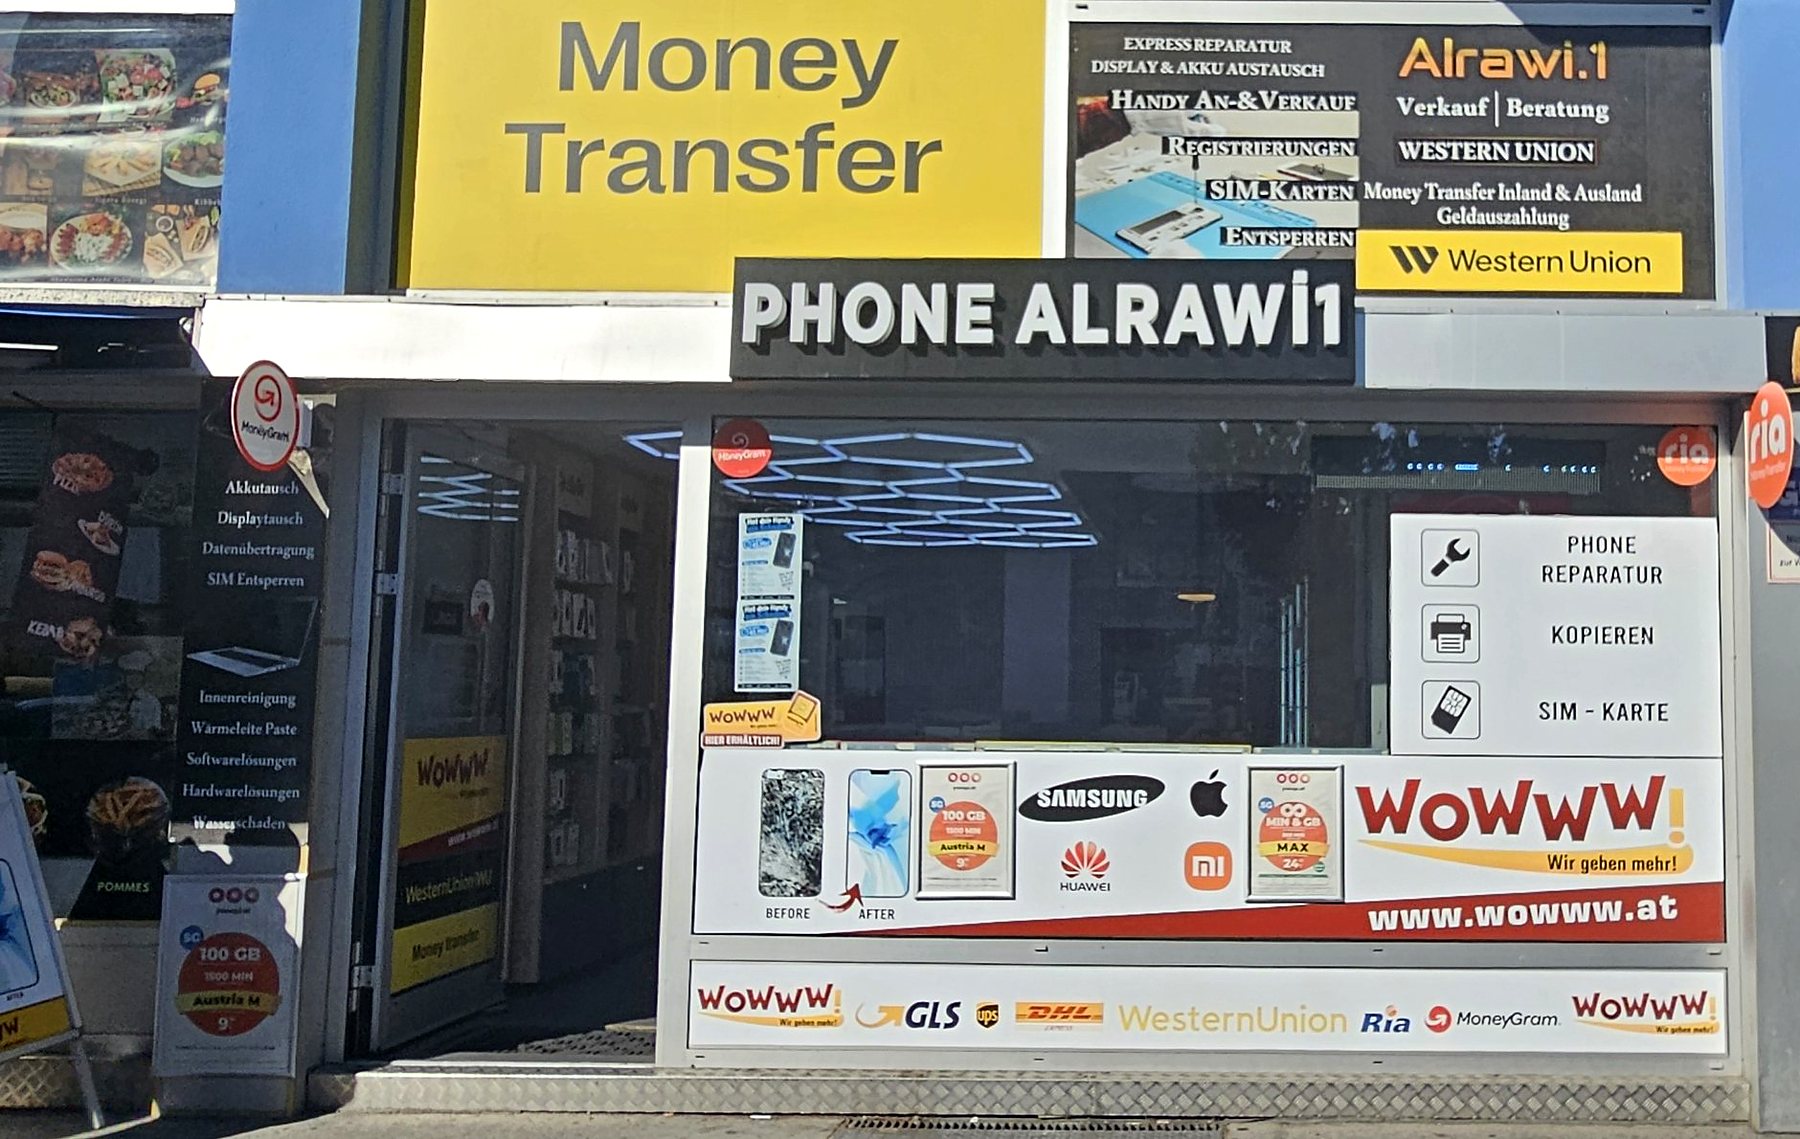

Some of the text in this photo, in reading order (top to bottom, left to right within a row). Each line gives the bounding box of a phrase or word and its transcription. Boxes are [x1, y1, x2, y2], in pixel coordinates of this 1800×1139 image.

[1124, 37, 1292, 53] EXPRESS REPARATUR
[559, 21, 900, 109] Money
[1091, 60, 1325, 78] DISPLAY & AKKU AUSTAUSCH
[1396, 96, 1610, 124] Verkauf Beratung
[505, 122, 942, 194] Transfer
[1399, 141, 1595, 162] WESTERN UNION
[1363, 182, 1642, 205] Money Transfer Inland & Ausland
[1437, 206, 1570, 231] Geldauszahlung
[1448, 248, 1651, 274] Western Union
[741, 282, 998, 347] PHONE
[241, 420, 290, 442] MoneyGram
[1750, 399, 1786, 465] ria
[1664, 433, 1709, 465] ria
[225, 480, 299, 496] Akkutausch
[217, 510, 303, 529] Displaytausch
[202, 541, 315, 560] Datenübertragung
[1568, 535, 1636, 555] PHONE
[207, 573, 305, 590] SIM Entsperren
[1541, 565, 1663, 585] REPARATUR
[1551, 626, 1654, 645] KOPIEREN
[199, 690, 296, 709] Innenreinigung
[1539, 702, 1577, 721] SIM
[1602, 702, 1669, 722] KARTE
[265, 721, 298, 735] Paste
[186, 752, 297, 771] Softwarelösungen
[1037, 789, 1148, 809] SAMSUNG
[966, 810, 986, 821] GB
[940, 842, 974, 851] Austria
[1277, 843, 1309, 852] MAX
[1547, 854, 1677, 874] Wir geben mehr!
[97, 882, 149, 893] POMMES
[1060, 882, 1111, 892] HUAWEI
[766, 908, 895, 920] BEFORE AFTER
[1368, 894, 1679, 931] www.wowww.at
[200, 949, 260, 962] 100 GB
[192, 994, 260, 1006] Austria M
[905, 1001, 962, 1029] GLS
[1028, 1006, 1092, 1019] DHL
[1360, 1004, 1411, 1033] Ria
[1457, 1011, 1559, 1029] MoneyGram
